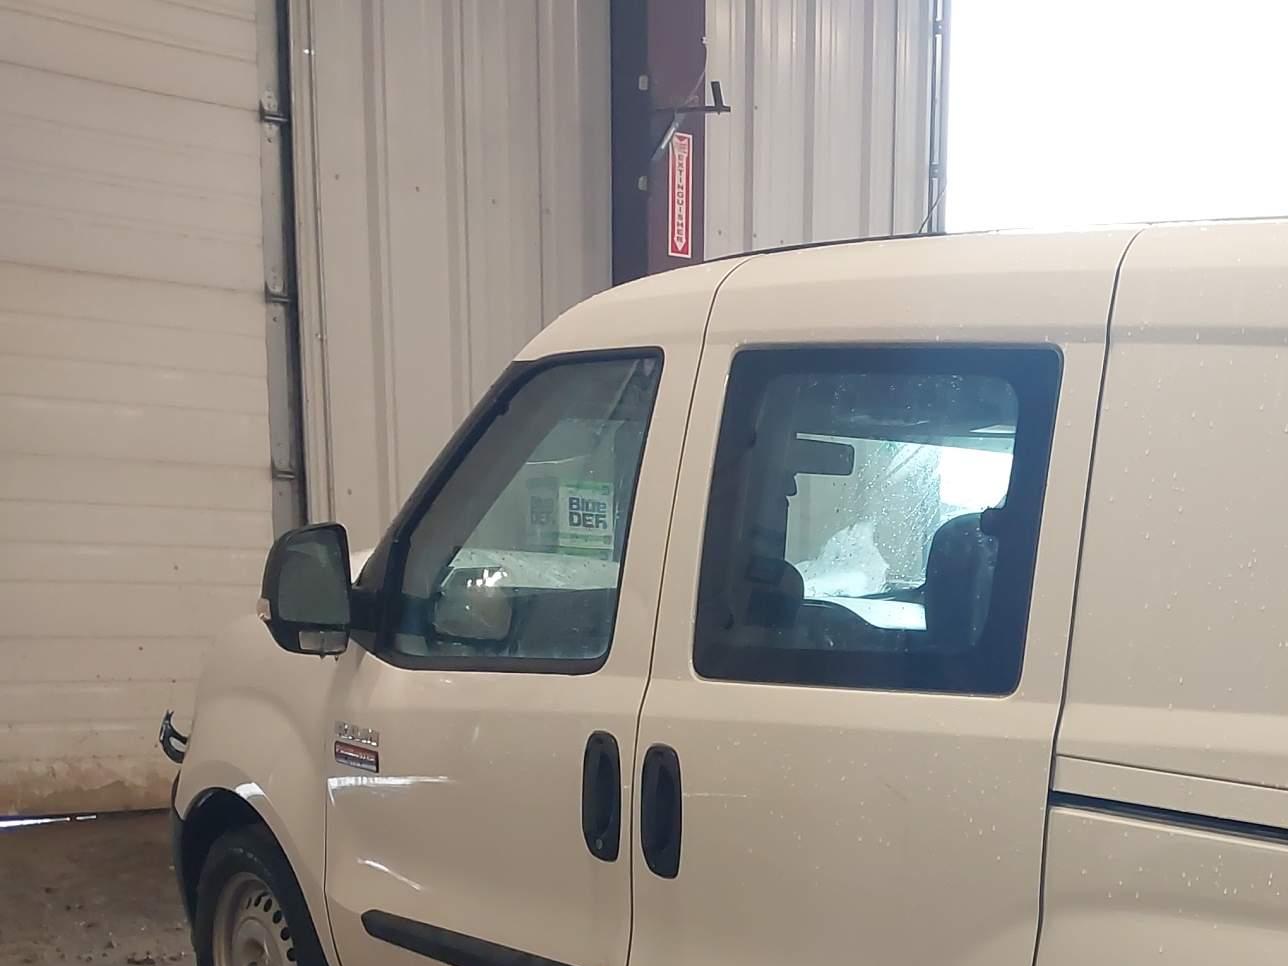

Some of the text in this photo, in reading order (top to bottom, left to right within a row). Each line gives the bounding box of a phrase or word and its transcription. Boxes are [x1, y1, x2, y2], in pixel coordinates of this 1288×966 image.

[676, 154, 684, 244] EXTINGUISHER
[568, 496, 607, 513] Blue
[568, 511, 608, 529] DEF
